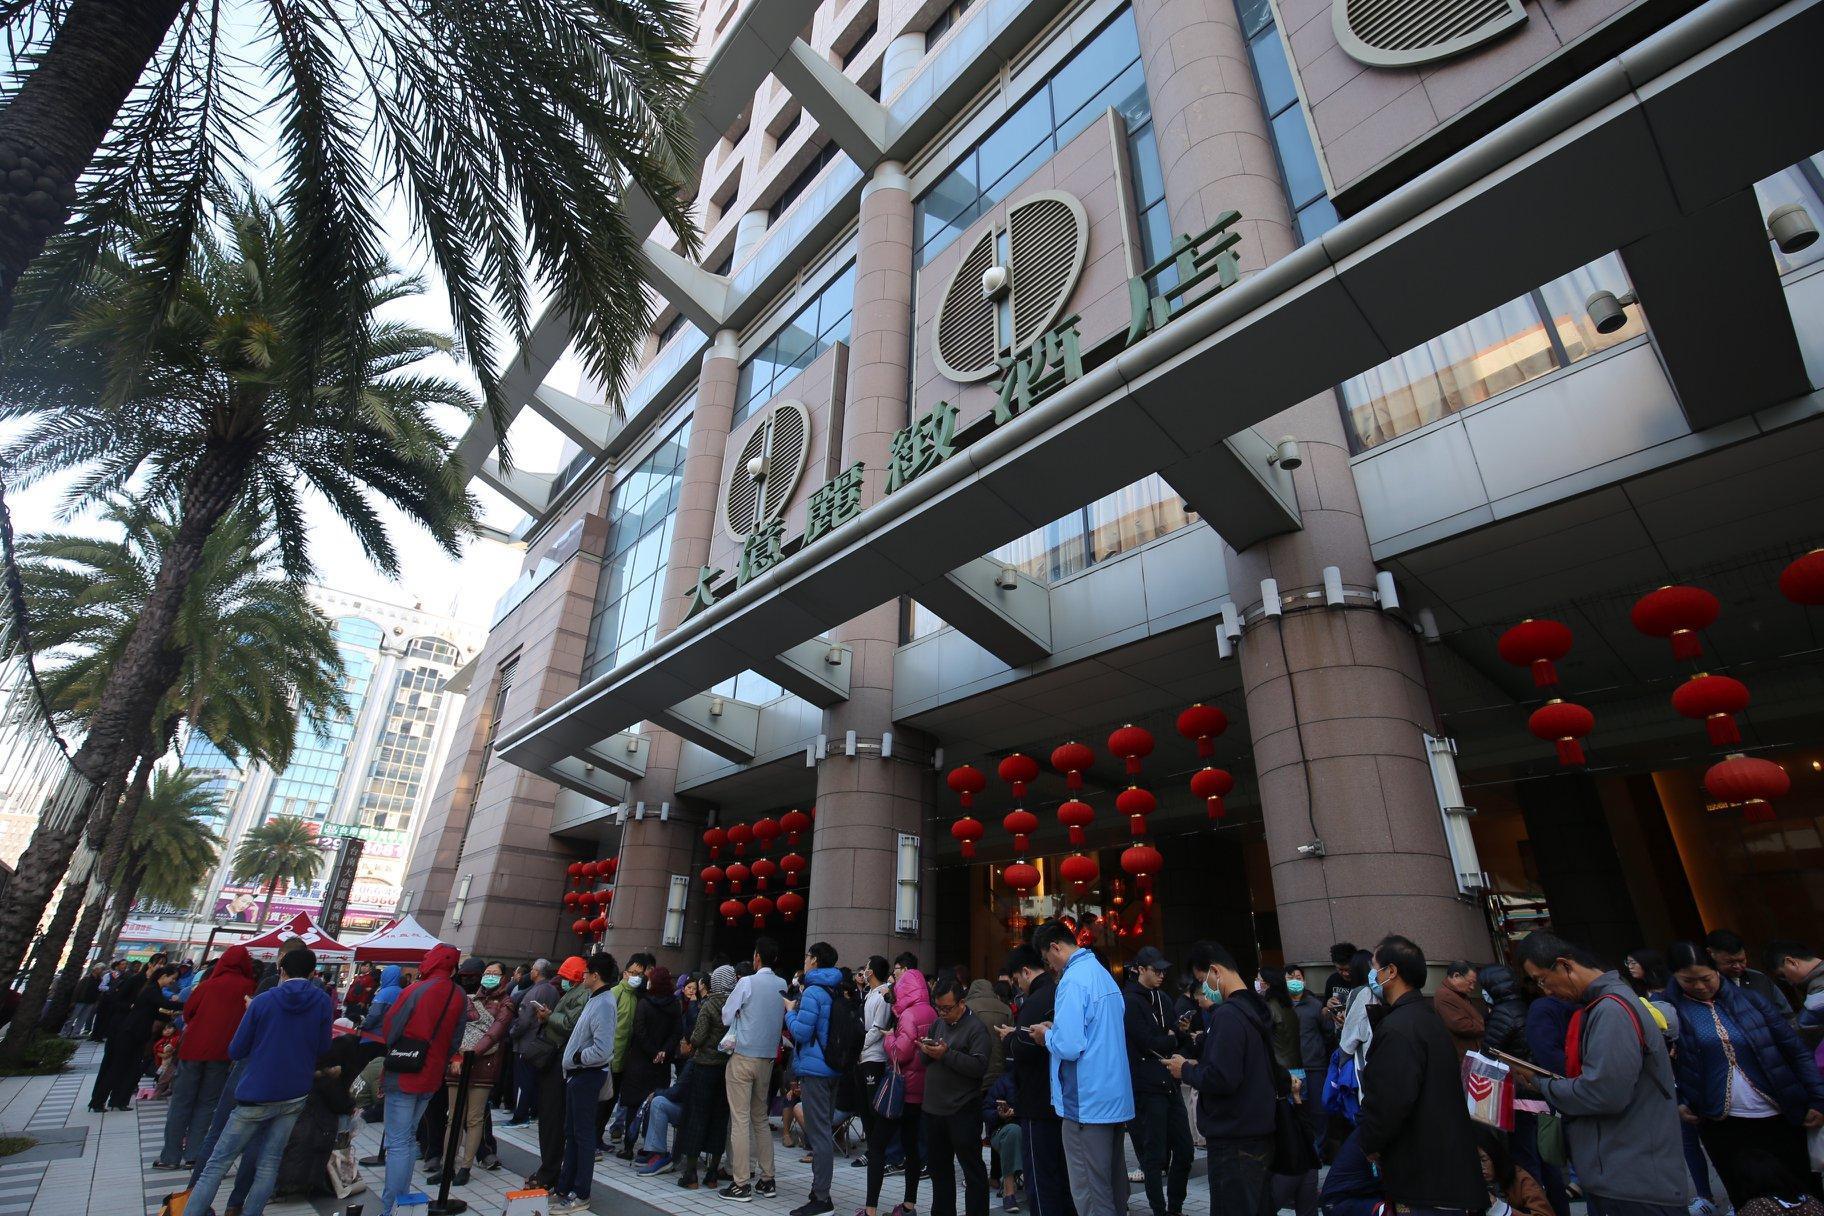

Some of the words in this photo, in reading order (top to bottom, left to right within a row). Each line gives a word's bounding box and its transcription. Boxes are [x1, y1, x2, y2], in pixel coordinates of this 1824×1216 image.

[679, 210, 1242, 623] 大億麗緻酒店
